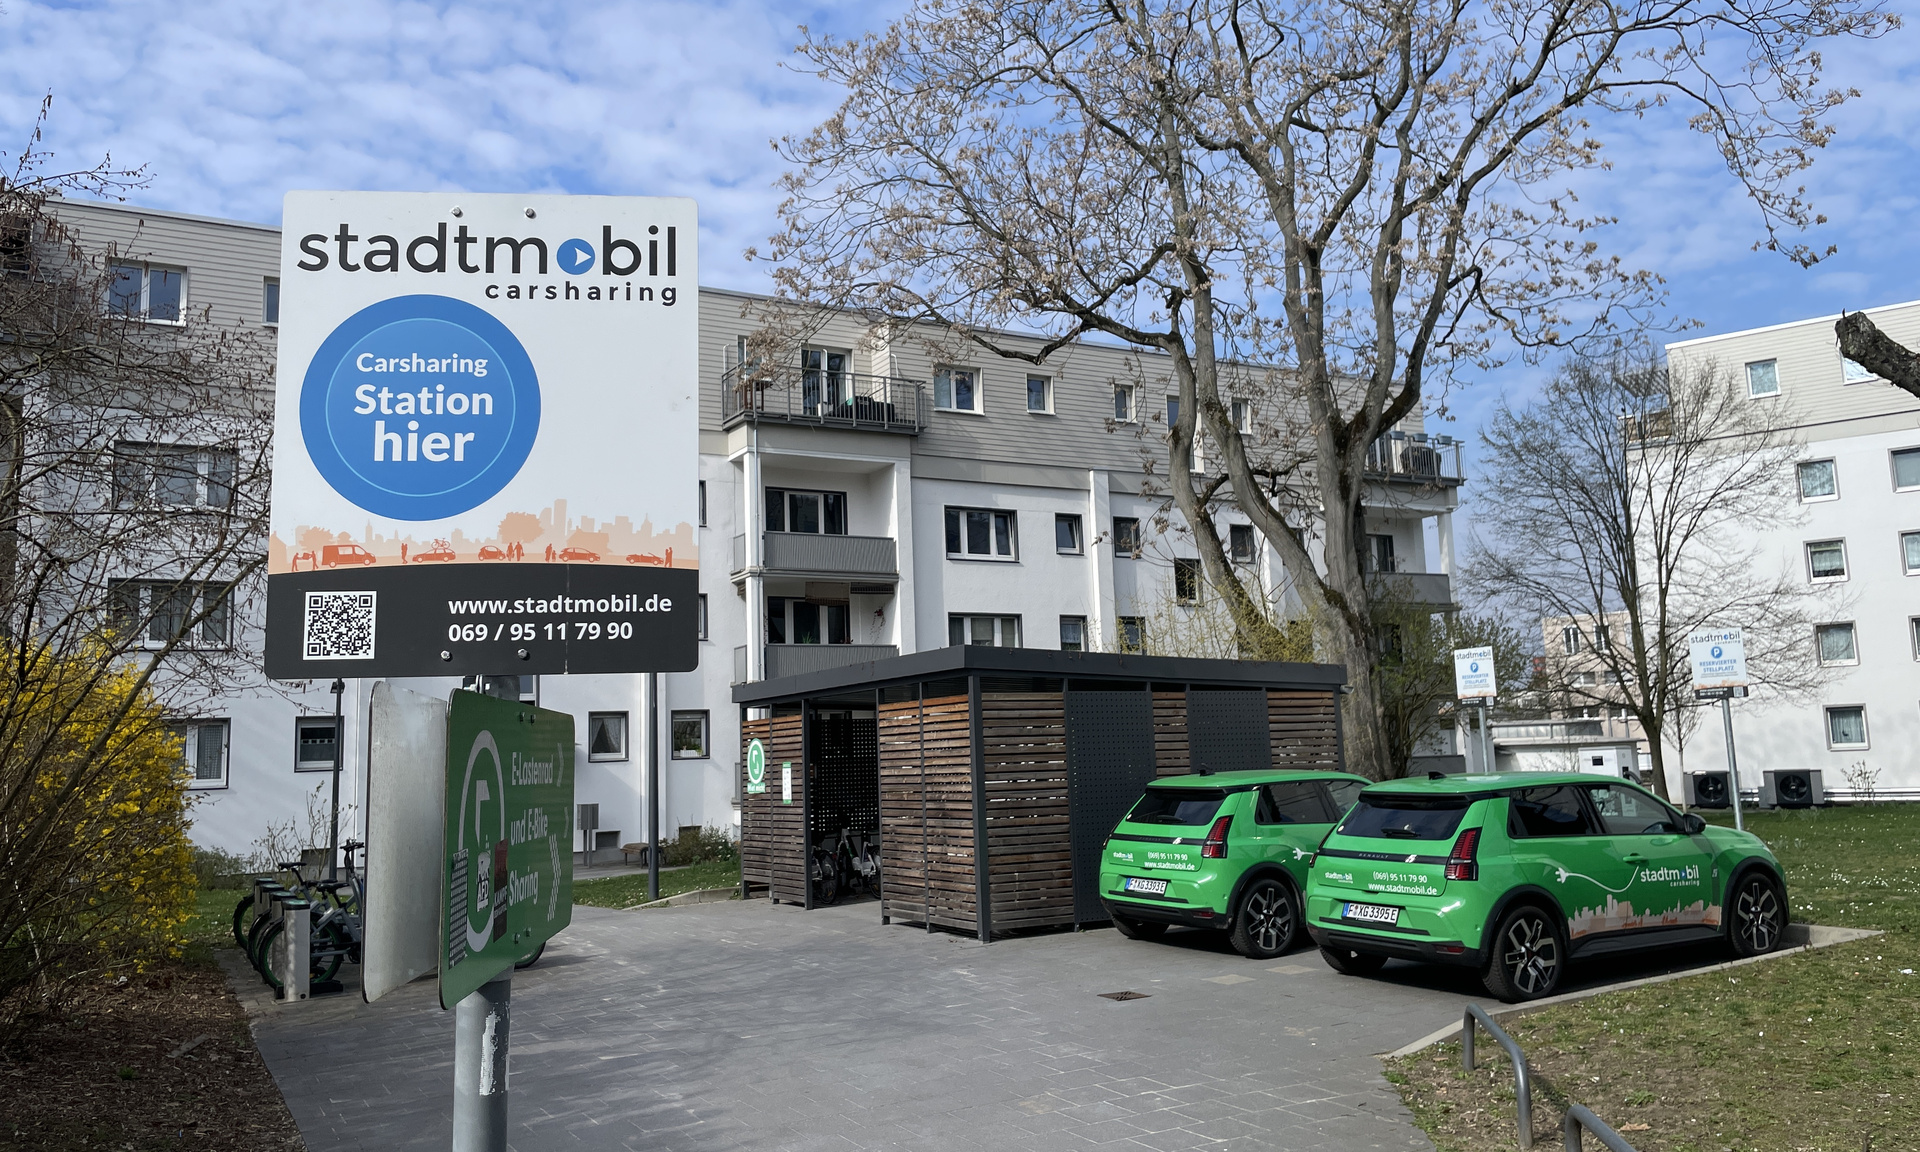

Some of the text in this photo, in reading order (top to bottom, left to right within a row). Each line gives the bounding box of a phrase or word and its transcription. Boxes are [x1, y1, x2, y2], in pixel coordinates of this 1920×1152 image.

[297, 222, 677, 277] stadtmobil
[485, 280, 677, 307] carsharing
[356, 352, 488, 377] Carsharing
[353, 384, 493, 415] Station
[373, 420, 475, 462] hier
[448, 594, 673, 615] www.stadtmobil.de
[448, 622, 633, 642] 069 / 95 11 79 90
[1691, 631, 1740, 644] stadtmobil
[1699, 659, 1737, 667] RESERVIERTER
[1703, 665, 1734, 673] STELLPLATZ
[512, 752, 554, 785] E-Lastenrad
[510, 807, 549, 846] und E-Bike
[1144, 861, 1195, 871] www.stadtmobil.de
[509, 866, 539, 907] Sharing
[1372, 871, 1428, 883] (069) 95 11 79 90
[1670, 879, 1700, 887] carsharing
[1368, 883, 1437, 895] www.stadtmobil.de
